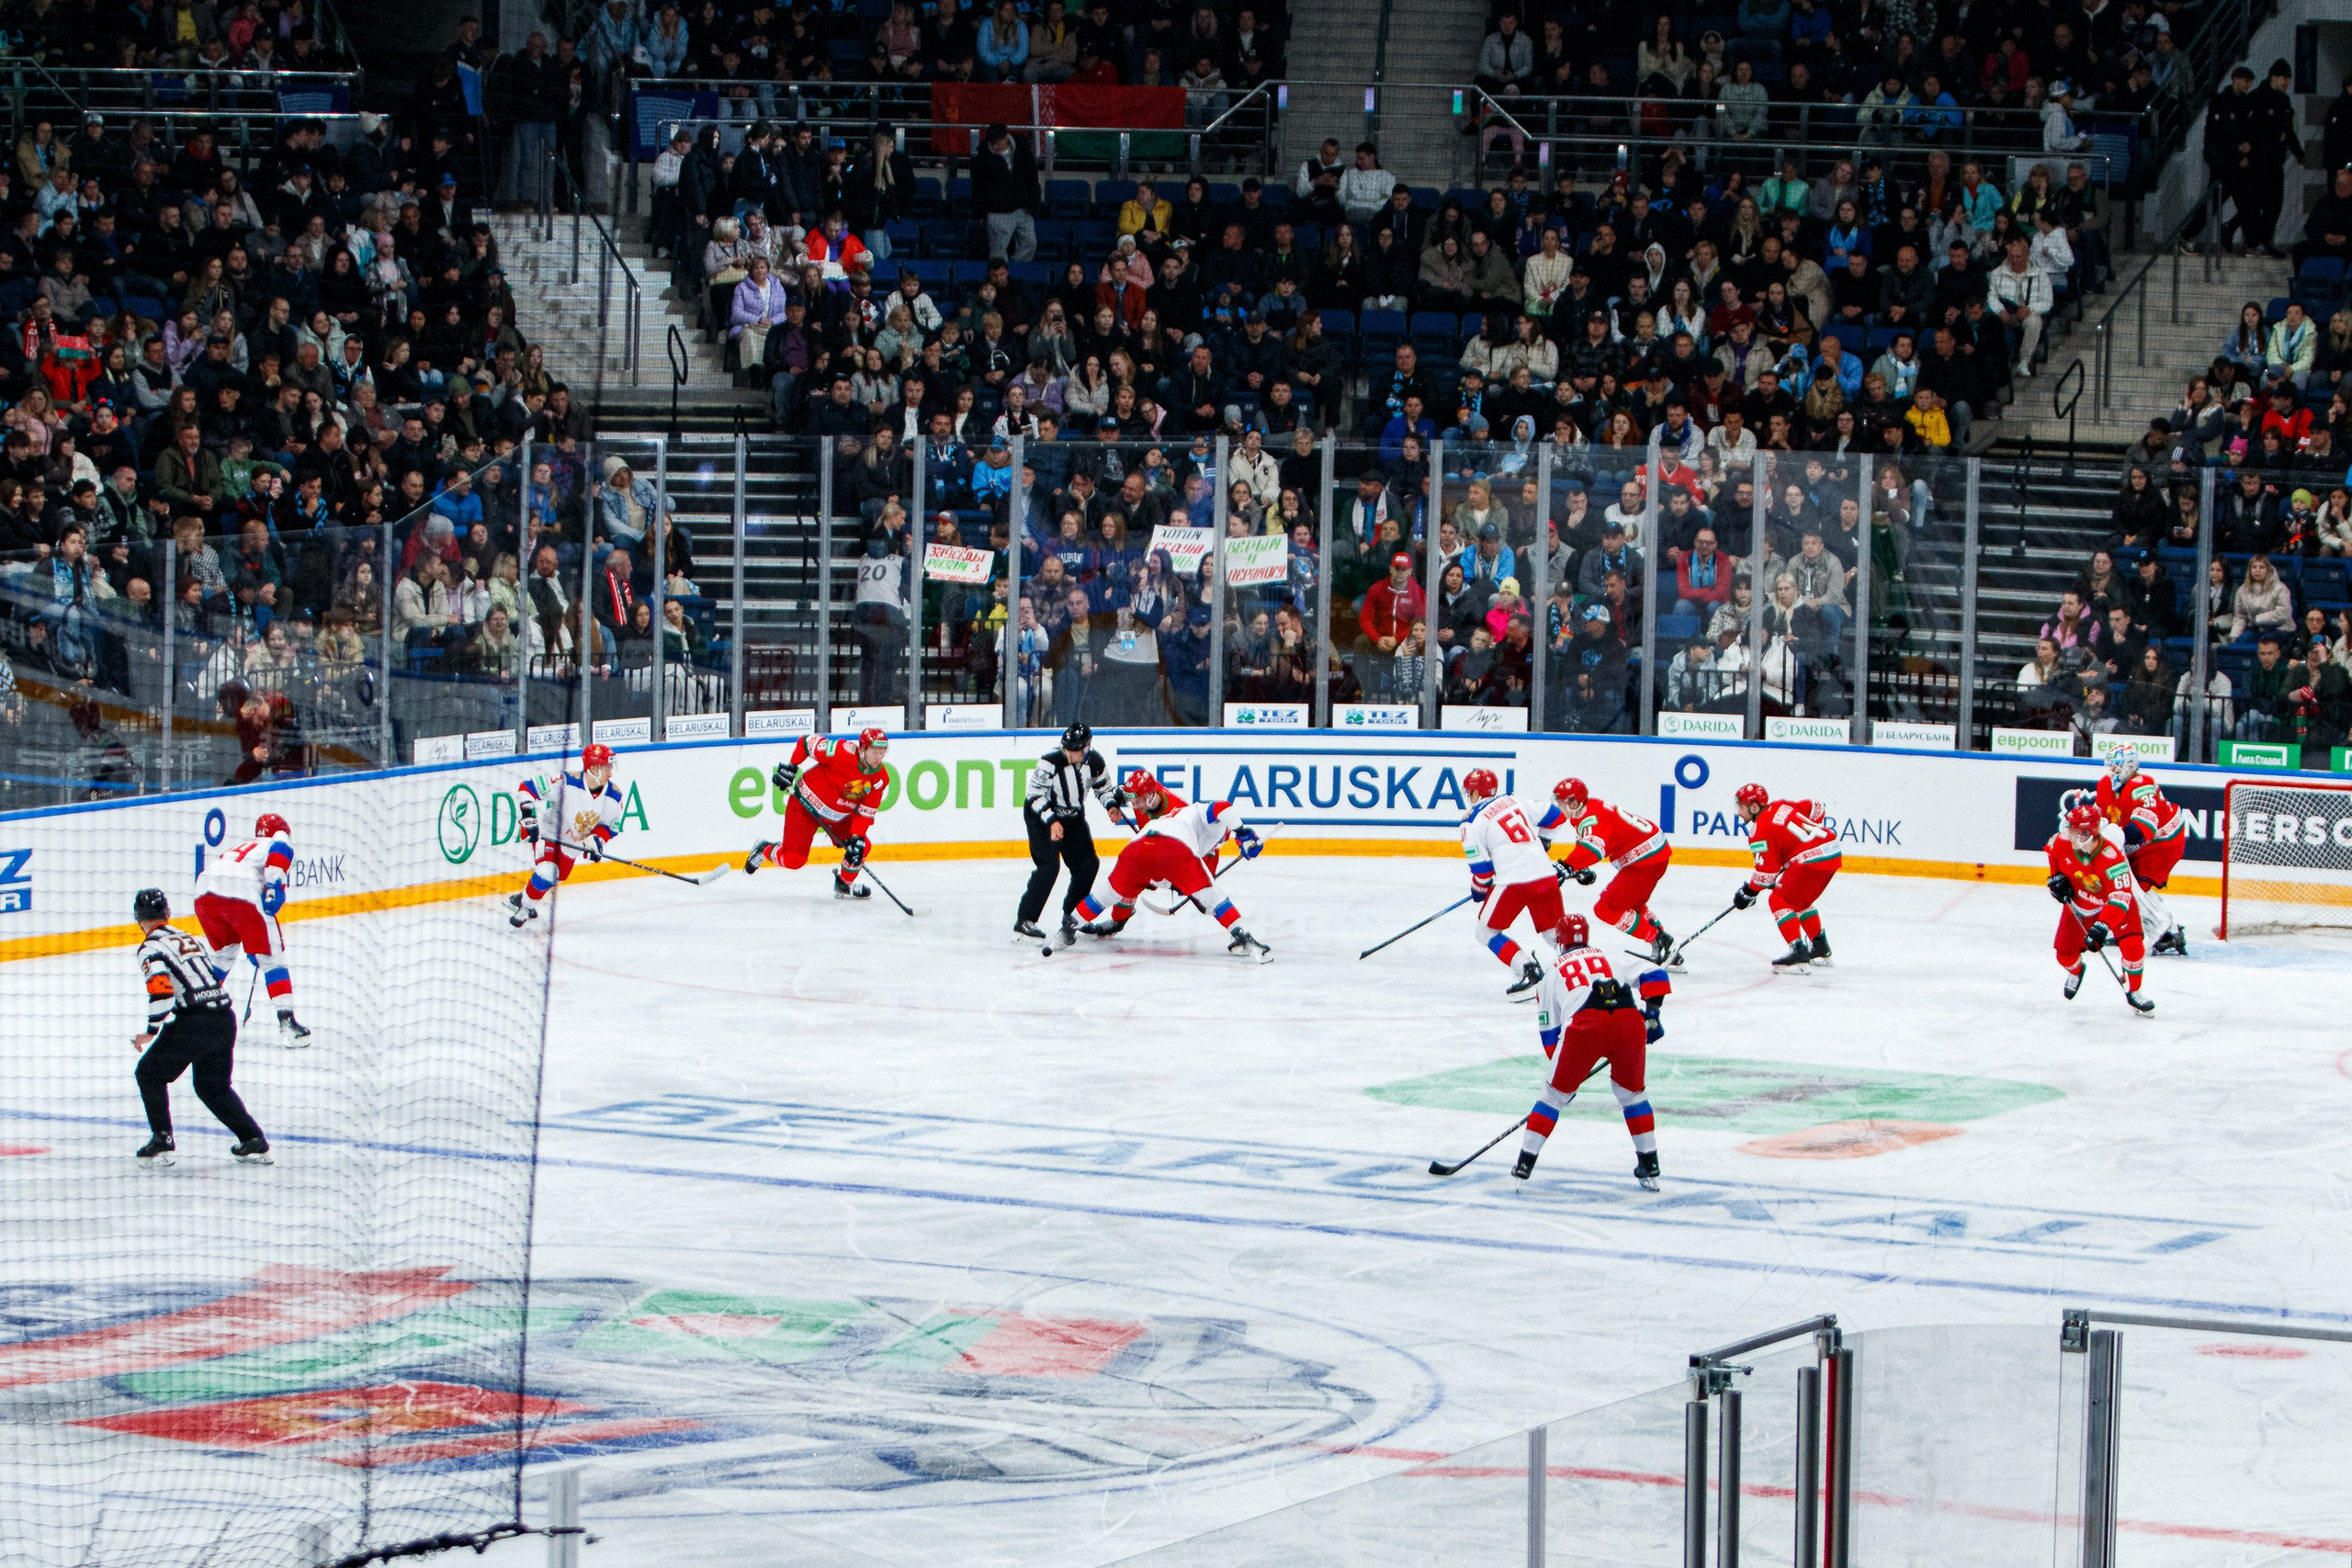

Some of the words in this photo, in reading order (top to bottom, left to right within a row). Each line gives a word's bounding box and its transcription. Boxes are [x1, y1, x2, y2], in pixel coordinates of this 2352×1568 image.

[860, 564, 888, 582] 20
[669, 721, 728, 735] BELARUSKALI
[748, 717, 812, 731] BELARUSKALI
[1683, 719, 1737, 733] DARIDA
[1791, 724, 1844, 738] DARIDA
[529, 731, 578, 746] BELARUSKALI
[595, 726, 649, 739] BELARUSKALI
[1885, 730, 1952, 742] БЕЛАРУСБАНК
[469, 737, 514, 752] BELARUSKALI
[1997, 736, 2068, 751] евроопт
[1118, 764, 1515, 811] ELARUSKAI
[2143, 794, 2157, 808] 35
[2181, 808, 2352, 847] NDERSO
[1559, 955, 1614, 992] 89
